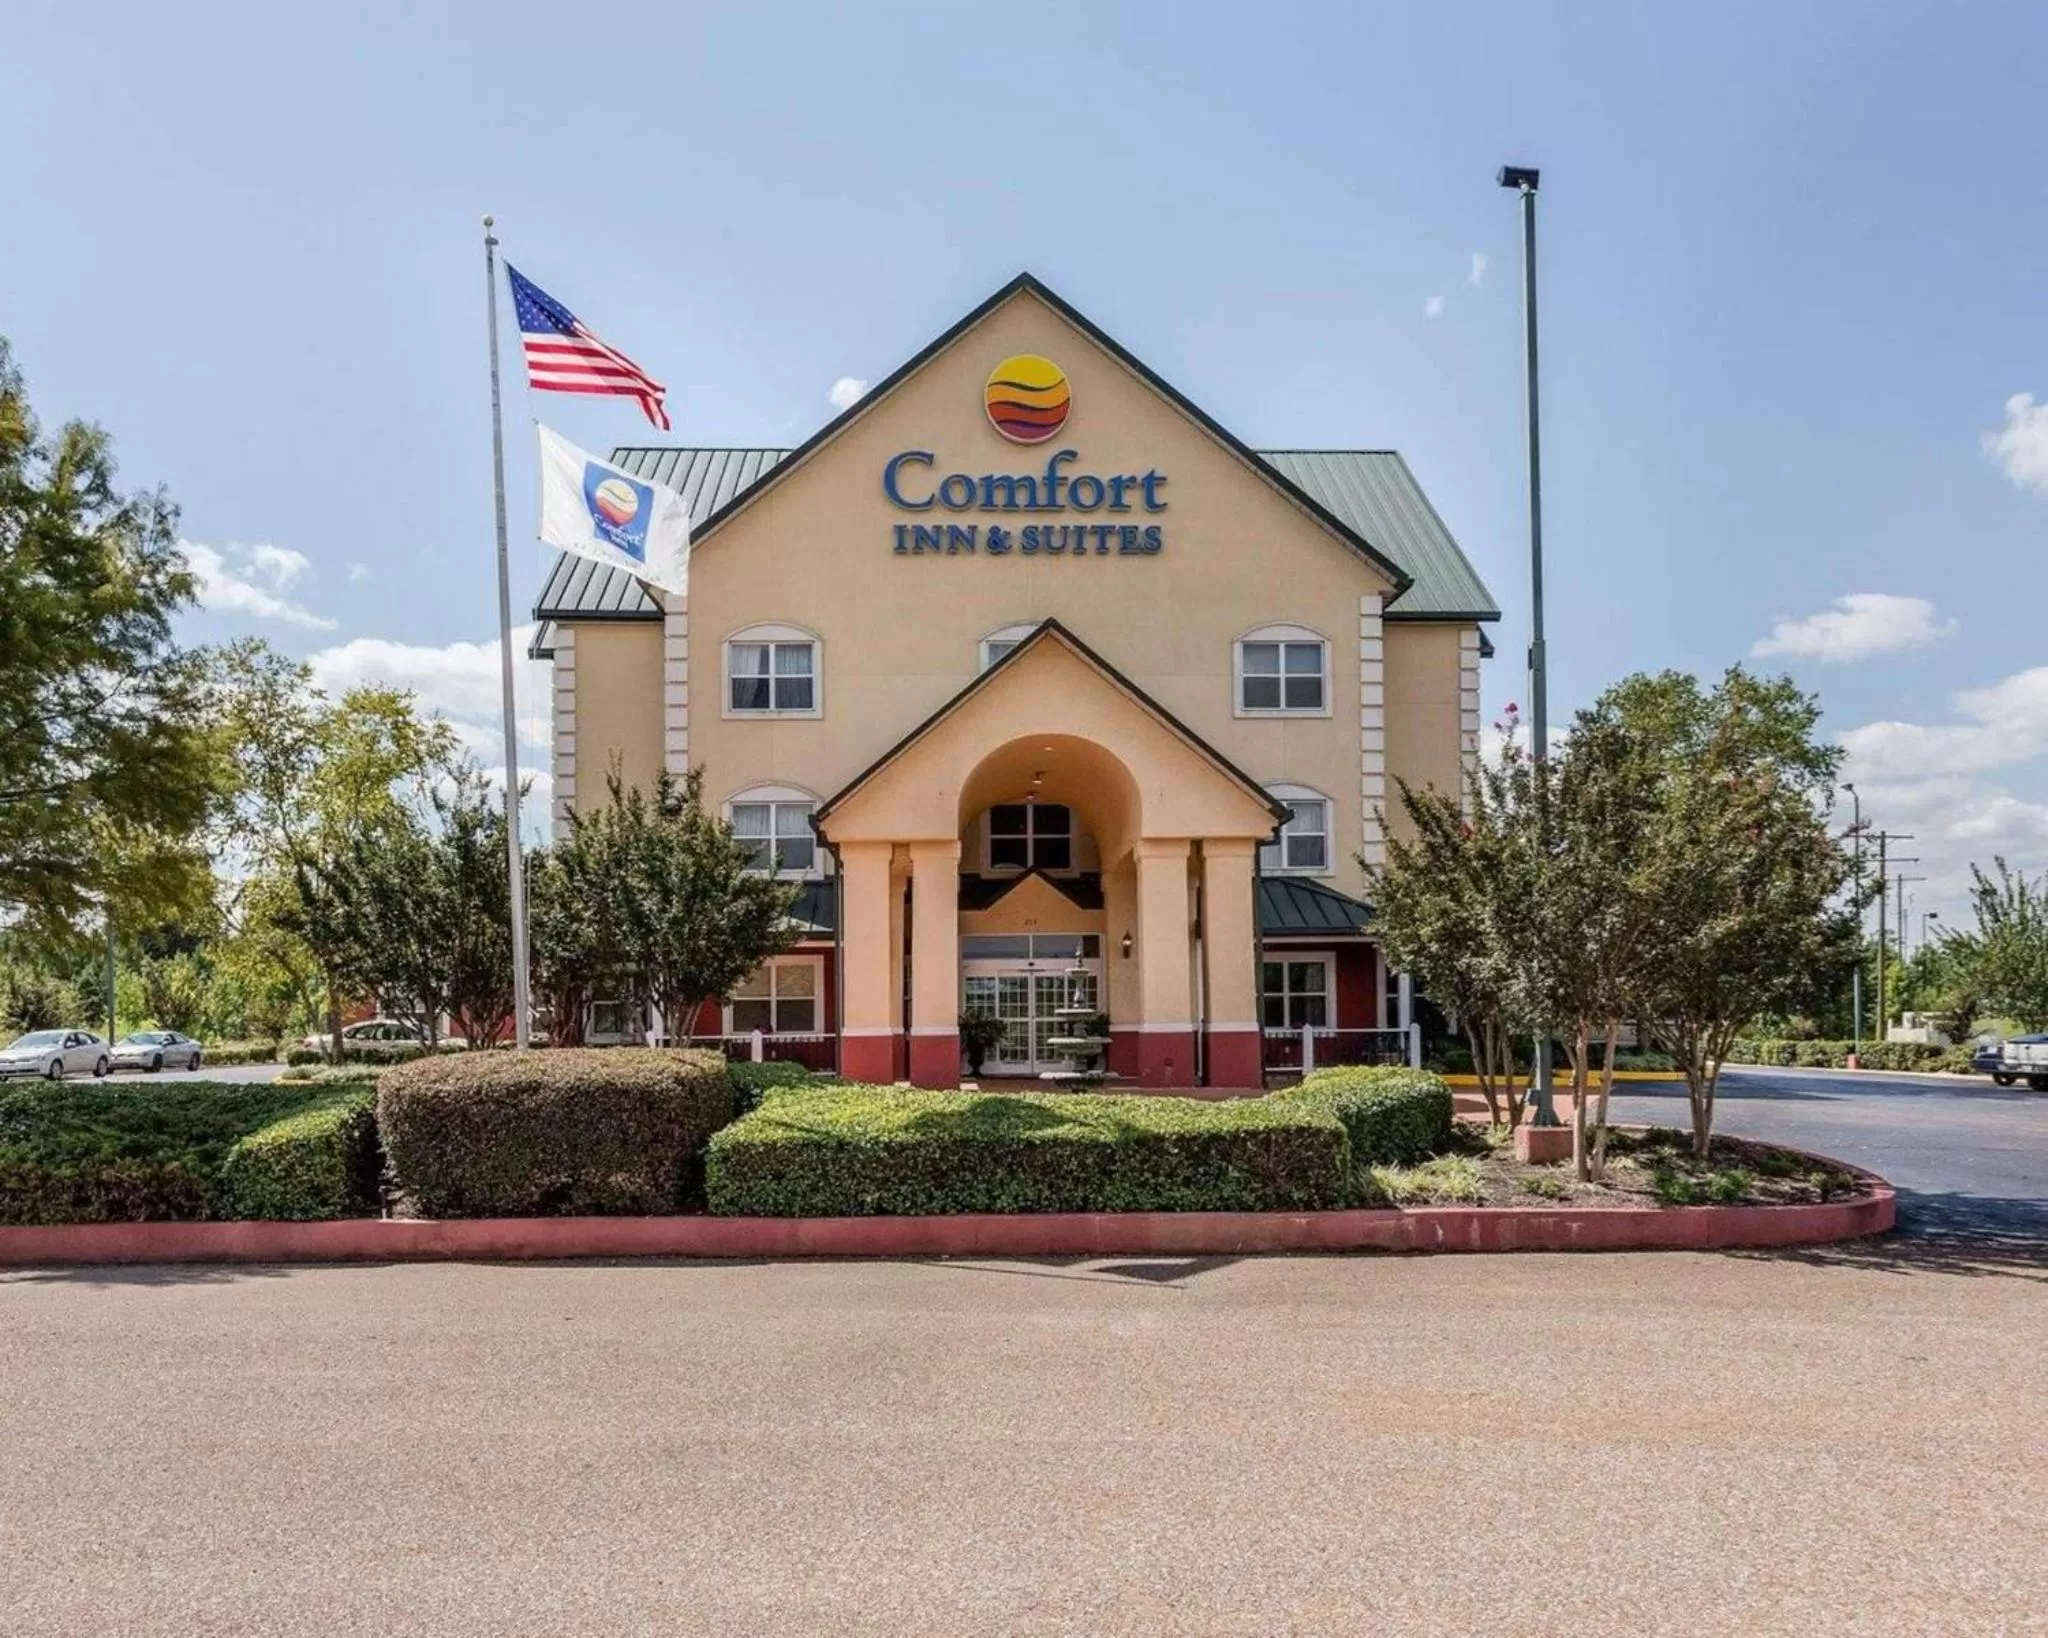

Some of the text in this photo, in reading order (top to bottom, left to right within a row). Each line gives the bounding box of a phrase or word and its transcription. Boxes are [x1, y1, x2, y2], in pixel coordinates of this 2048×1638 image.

[883, 450, 1168, 513] Comfort
[893, 524, 1162, 555] INN & SUITES
